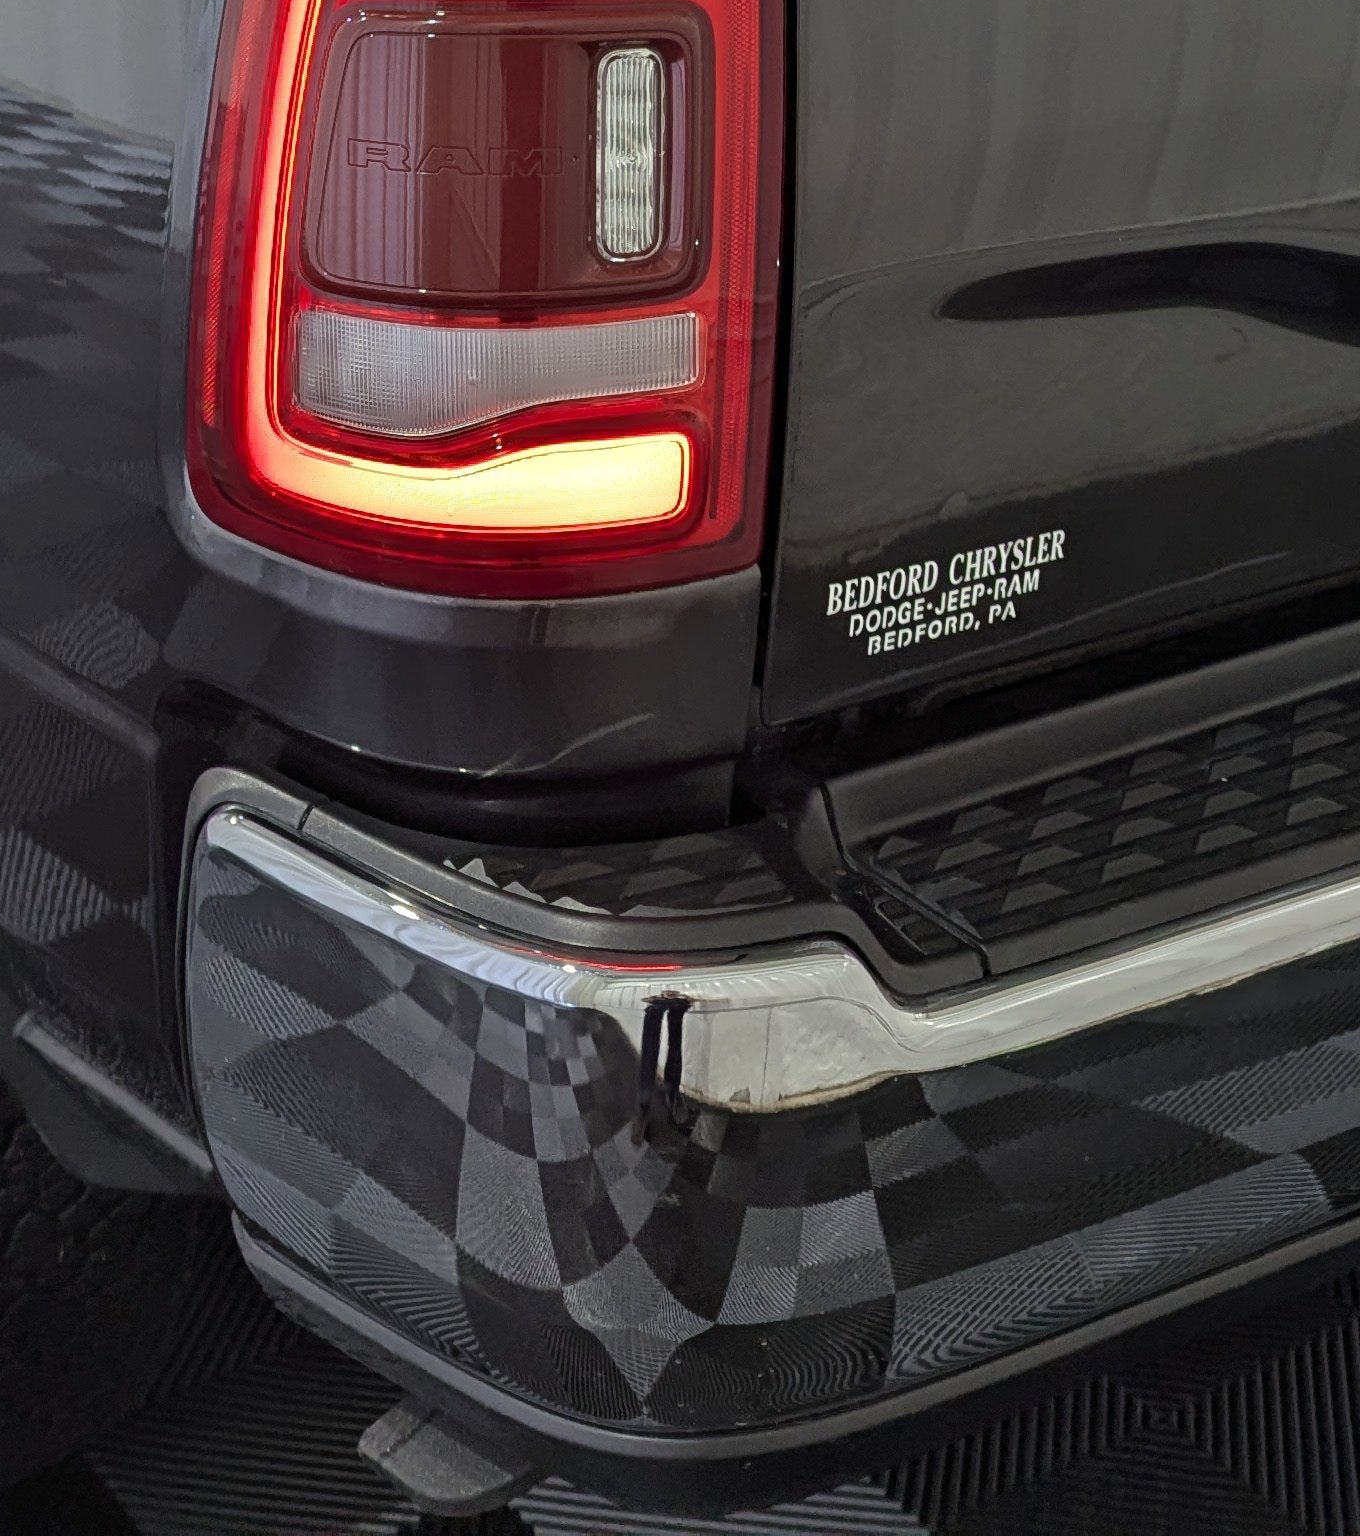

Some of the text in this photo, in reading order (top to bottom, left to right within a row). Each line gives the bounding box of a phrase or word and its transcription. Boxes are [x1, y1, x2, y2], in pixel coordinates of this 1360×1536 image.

[346, 137, 563, 176] RAM
[826, 529, 1066, 616] BEDFORD CHRYSLER
[867, 600, 1017, 656] BEDFORD, PA
